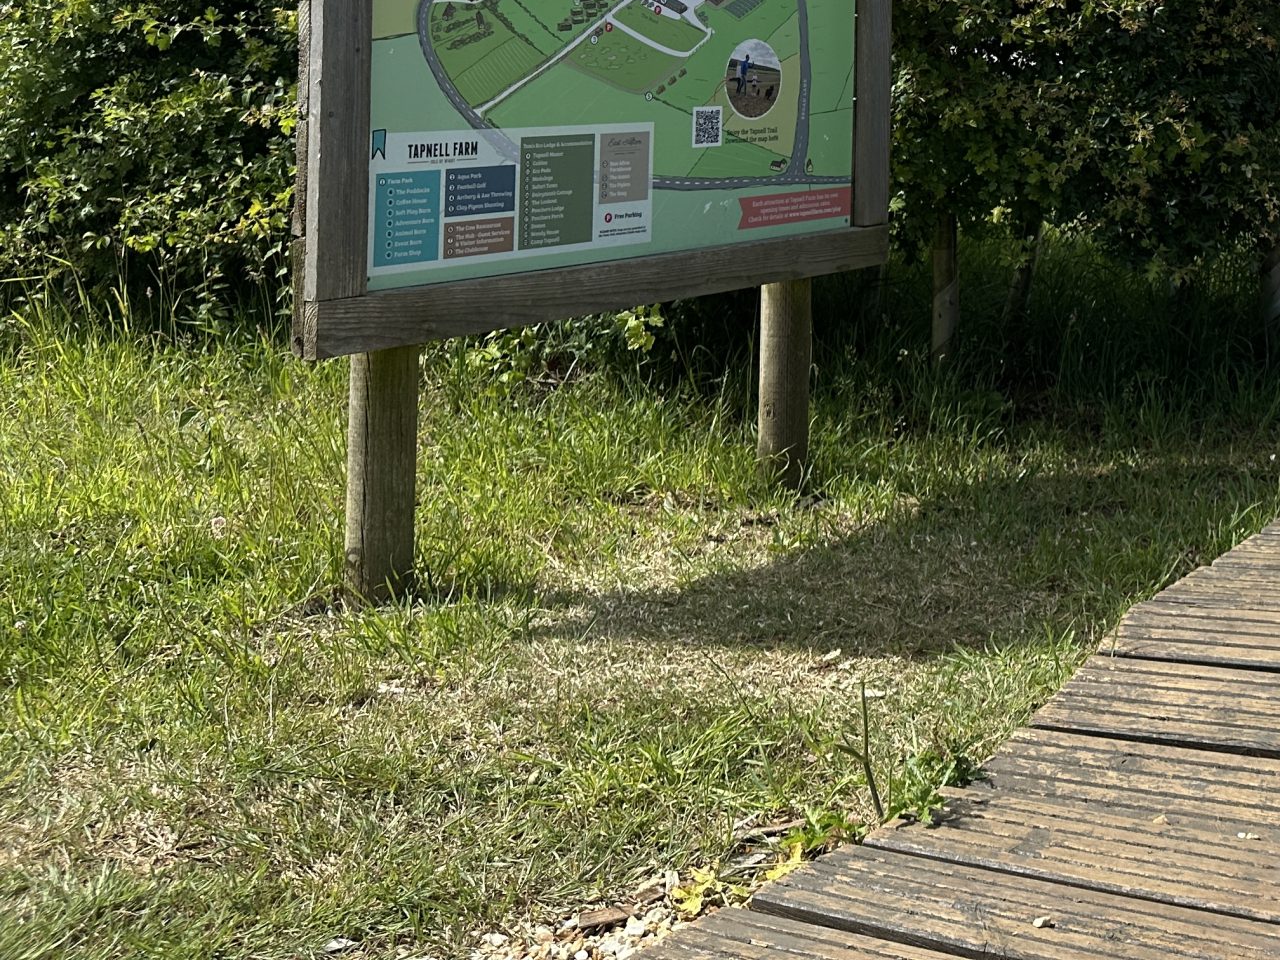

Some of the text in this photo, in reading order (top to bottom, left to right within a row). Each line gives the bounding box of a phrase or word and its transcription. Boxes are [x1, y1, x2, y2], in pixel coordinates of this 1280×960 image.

[408, 141, 478, 159] TAPNELL FARM
[625, 211, 642, 219] Parking
